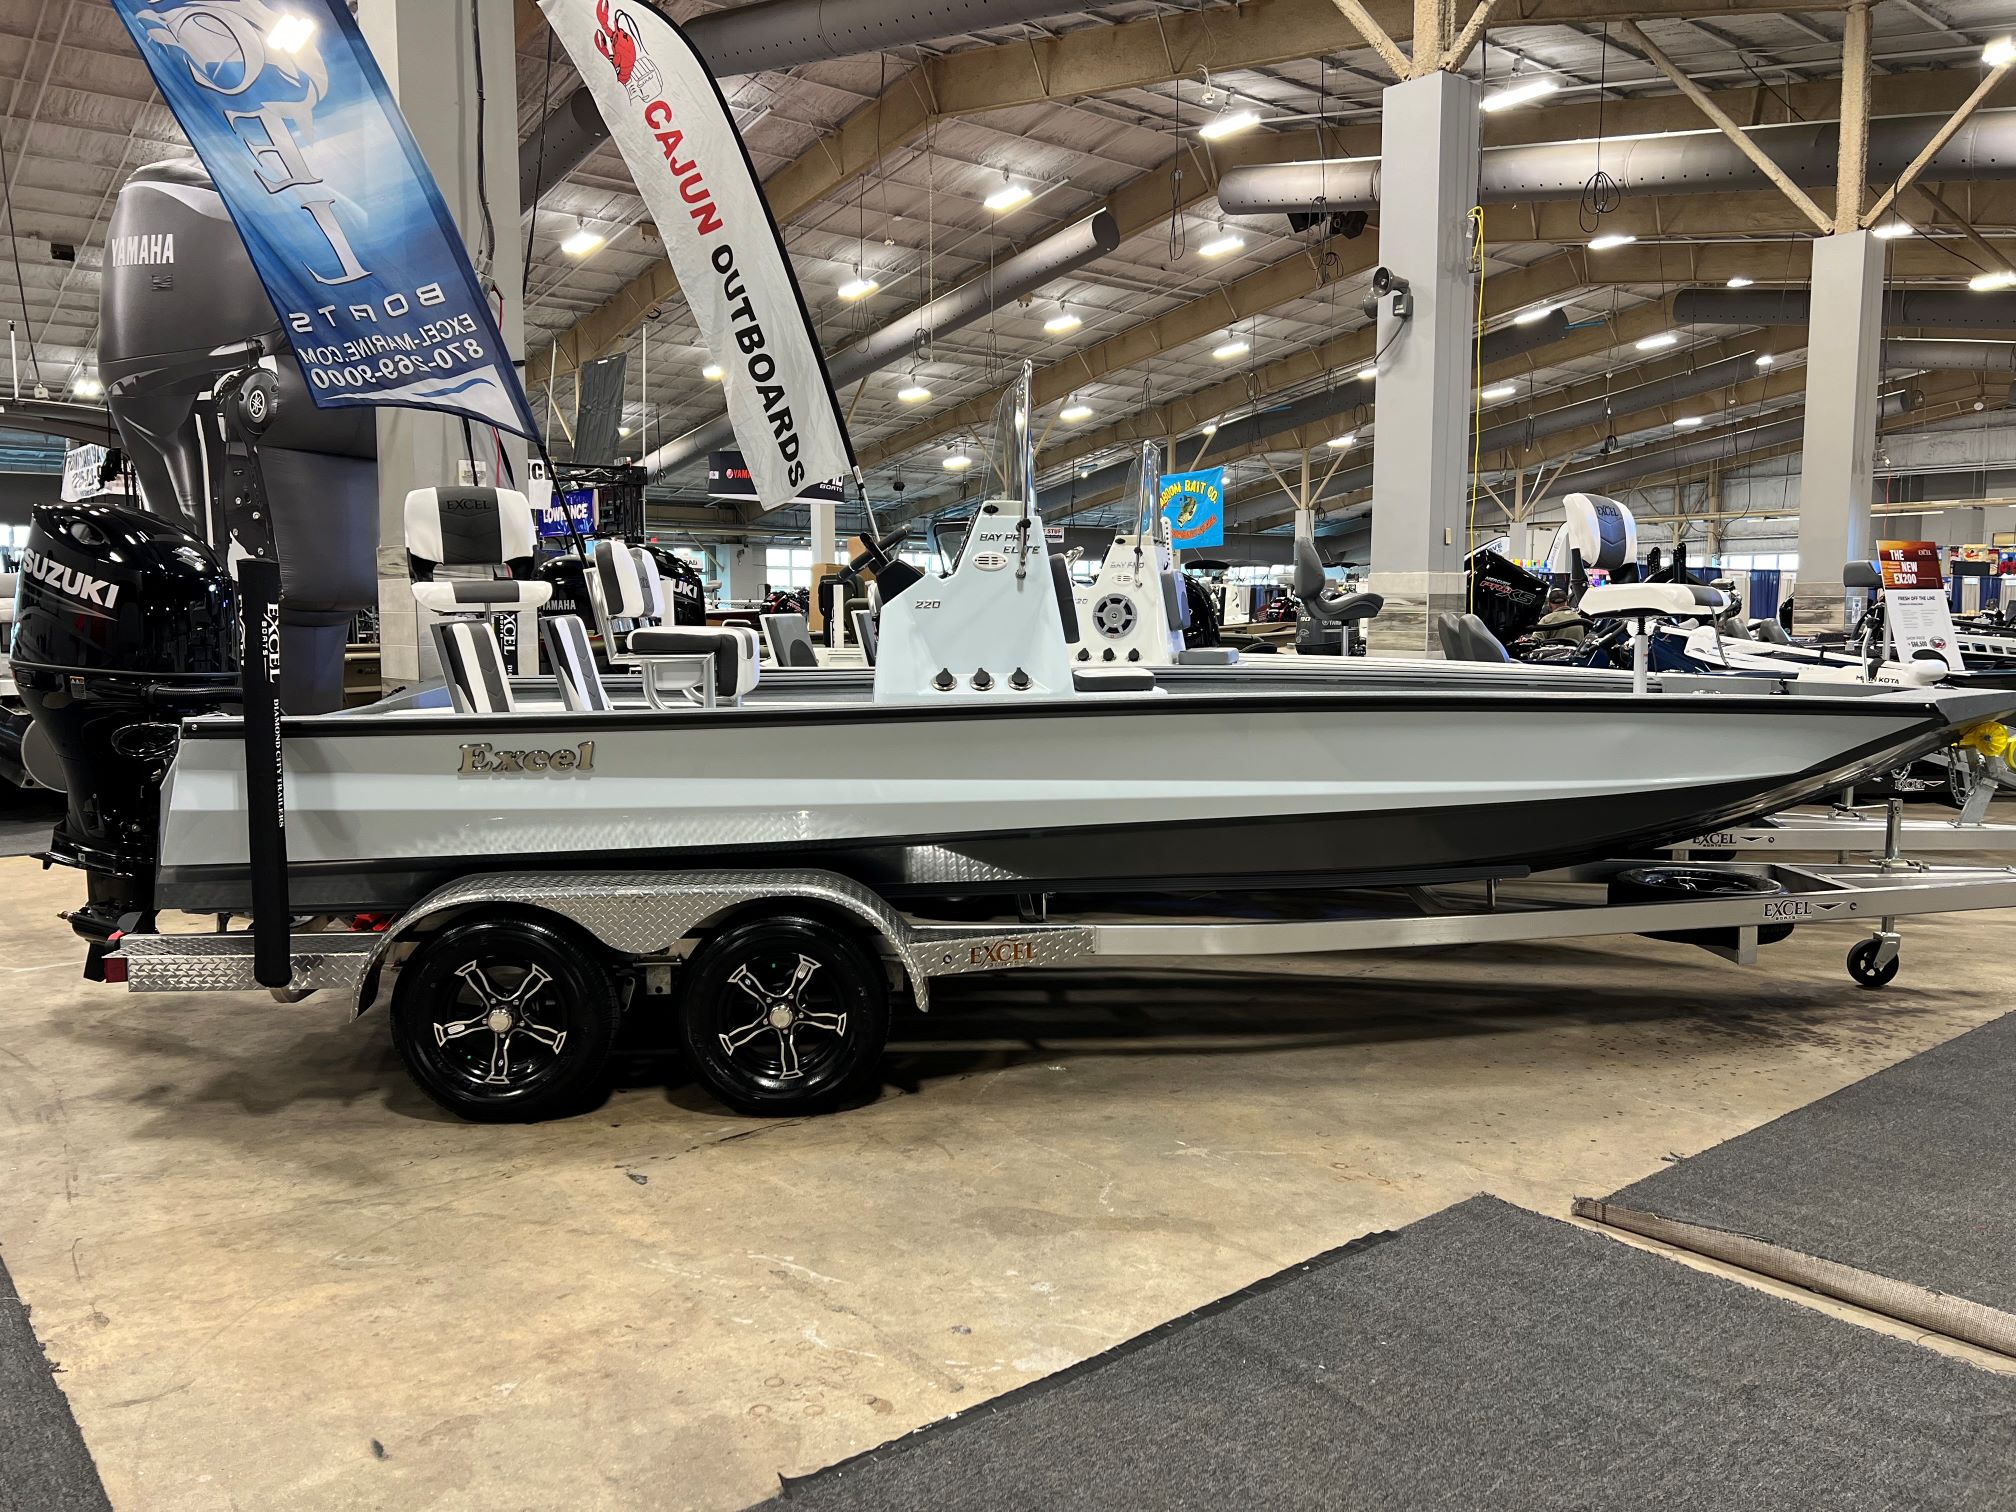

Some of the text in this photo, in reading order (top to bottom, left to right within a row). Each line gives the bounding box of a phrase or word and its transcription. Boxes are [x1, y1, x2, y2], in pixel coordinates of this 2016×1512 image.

[111, 233, 175, 268] YAMAHA
[644, 100, 806, 488] CAJUN OUTBOARDS
[820, 484, 843, 493] BOATS
[1185, 480, 1207, 495] BAIT
[446, 498, 491, 511] EXCEL
[1596, 504, 1619, 517] EXCEL
[543, 503, 589, 524] LOWRNCE
[979, 533, 1003, 542] BAY
[1003, 546, 1041, 555] ELTE
[1889, 549, 1905, 561] THE
[1901, 561, 1918, 573] NEW
[23, 548, 120, 609] SUZUKI
[1894, 573, 1917, 585] EX200
[915, 600, 941, 609] 220
[261, 620, 269, 656] BOATS
[503, 611, 517, 656] XCEL
[263, 602, 281, 683] EXCEL
[1878, 677, 1900, 685] KOTA
[273, 698, 281, 749] DIAMOND
[275, 750, 283, 774] CITY
[457, 740, 597, 773] Excel
[1692, 832, 1737, 846] EXCEL
[1764, 899, 1812, 918] EXCEL
[970, 937, 1037, 967] EXCEL
